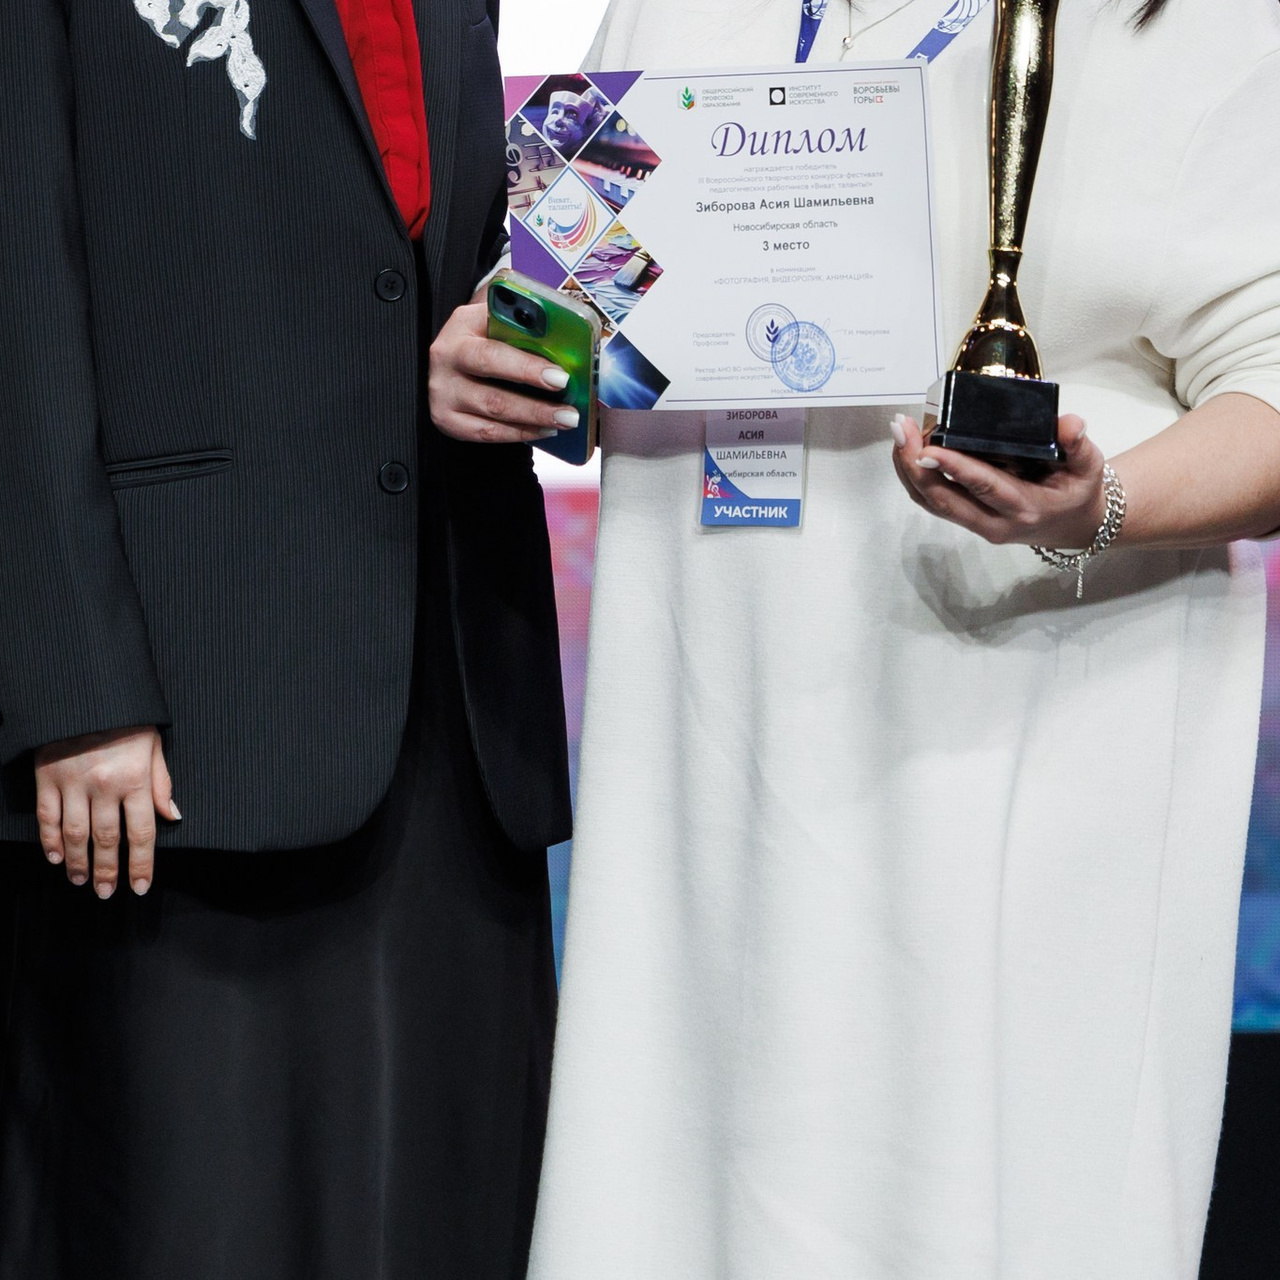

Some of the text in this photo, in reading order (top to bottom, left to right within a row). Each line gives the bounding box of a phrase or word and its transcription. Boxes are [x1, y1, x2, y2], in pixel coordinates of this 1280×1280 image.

[789, 91, 838, 99] СОВРЕМЕННОГО
[853, 85, 901, 94] ВОРОБЬЕВЫ
[853, 96, 875, 104] ГОРЫ
[711, 121, 869, 157] Диплом
[696, 196, 875, 214] Зиборова Асия Шамильевна
[733, 220, 838, 232] Новосибирская область
[762, 240, 810, 251] 3 место
[726, 410, 778, 421] ЗИБОРОВА
[738, 430, 764, 440] АСИЯ
[716, 450, 787, 461] ШАМИЛЬЕВНА
[766, 469, 797, 478] область
[714, 505, 788, 519] УЧАСТНИК
